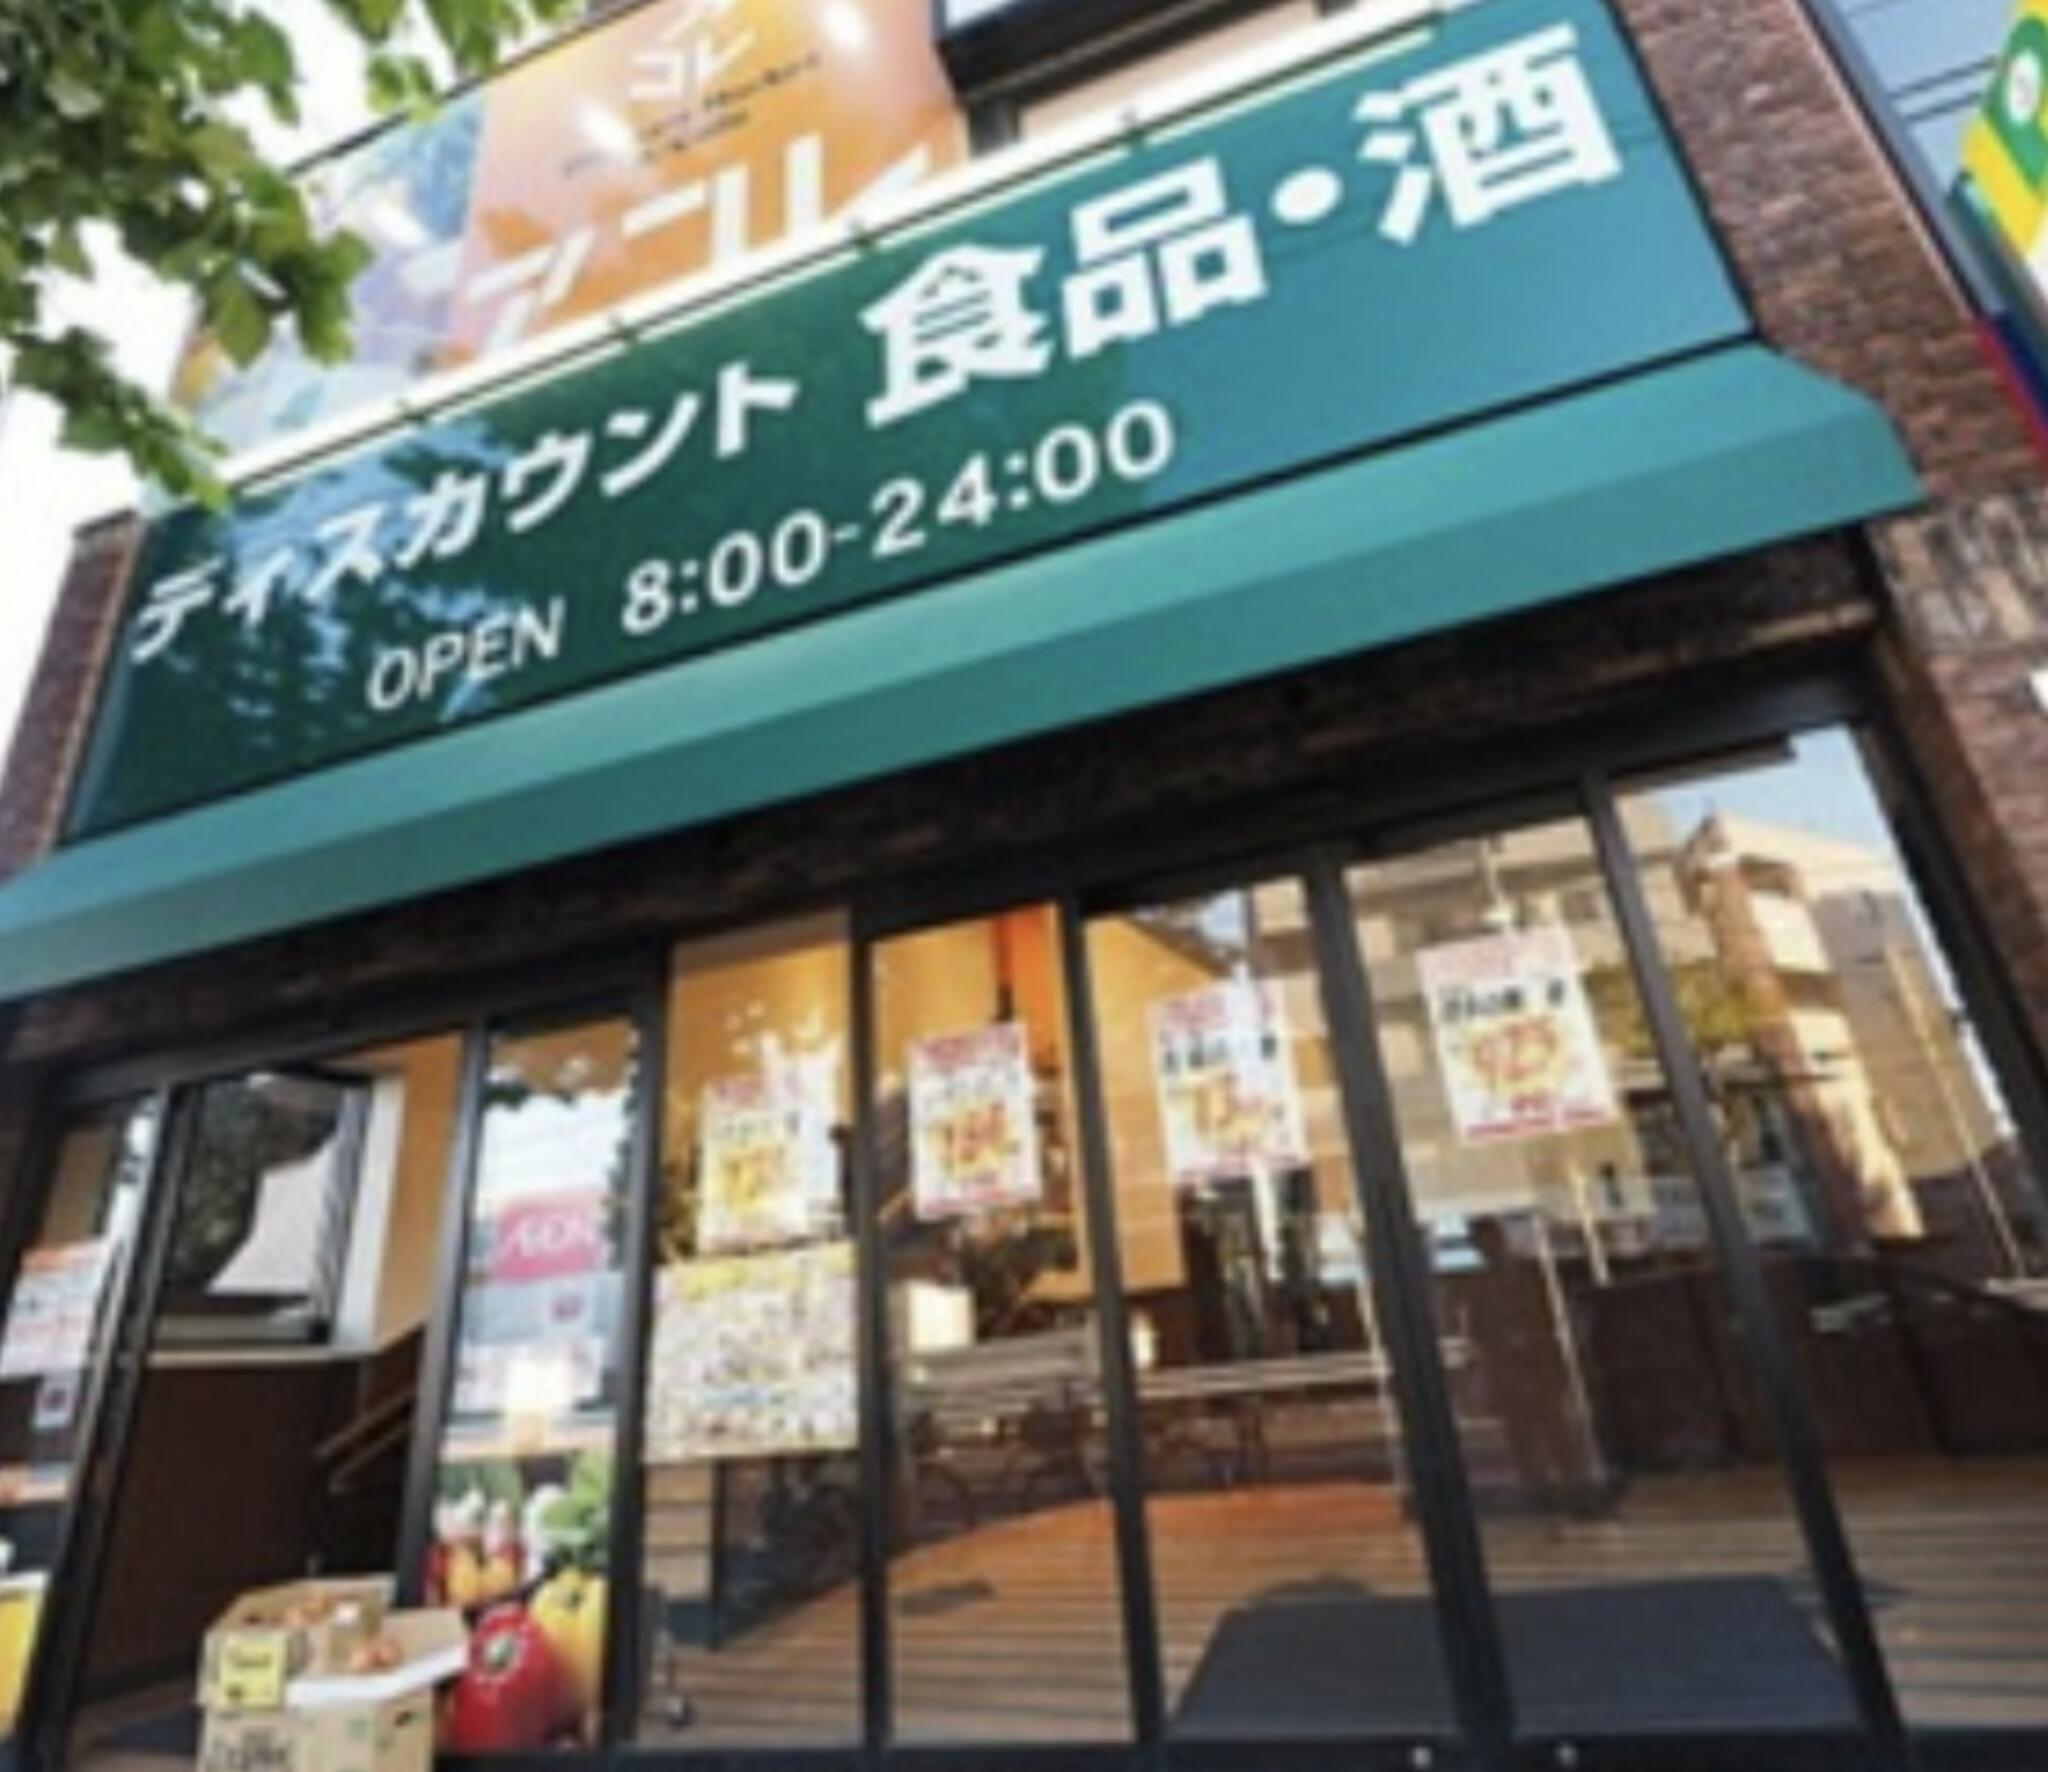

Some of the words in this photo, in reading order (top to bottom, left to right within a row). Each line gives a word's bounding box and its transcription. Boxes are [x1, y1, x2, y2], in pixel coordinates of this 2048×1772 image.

[129, 361, 799, 665] ディスカウント
[858, 21, 1624, 427] 食品・酒
[365, 596, 567, 712] OPEN
[619, 400, 1176, 636] 8:00-24:00
